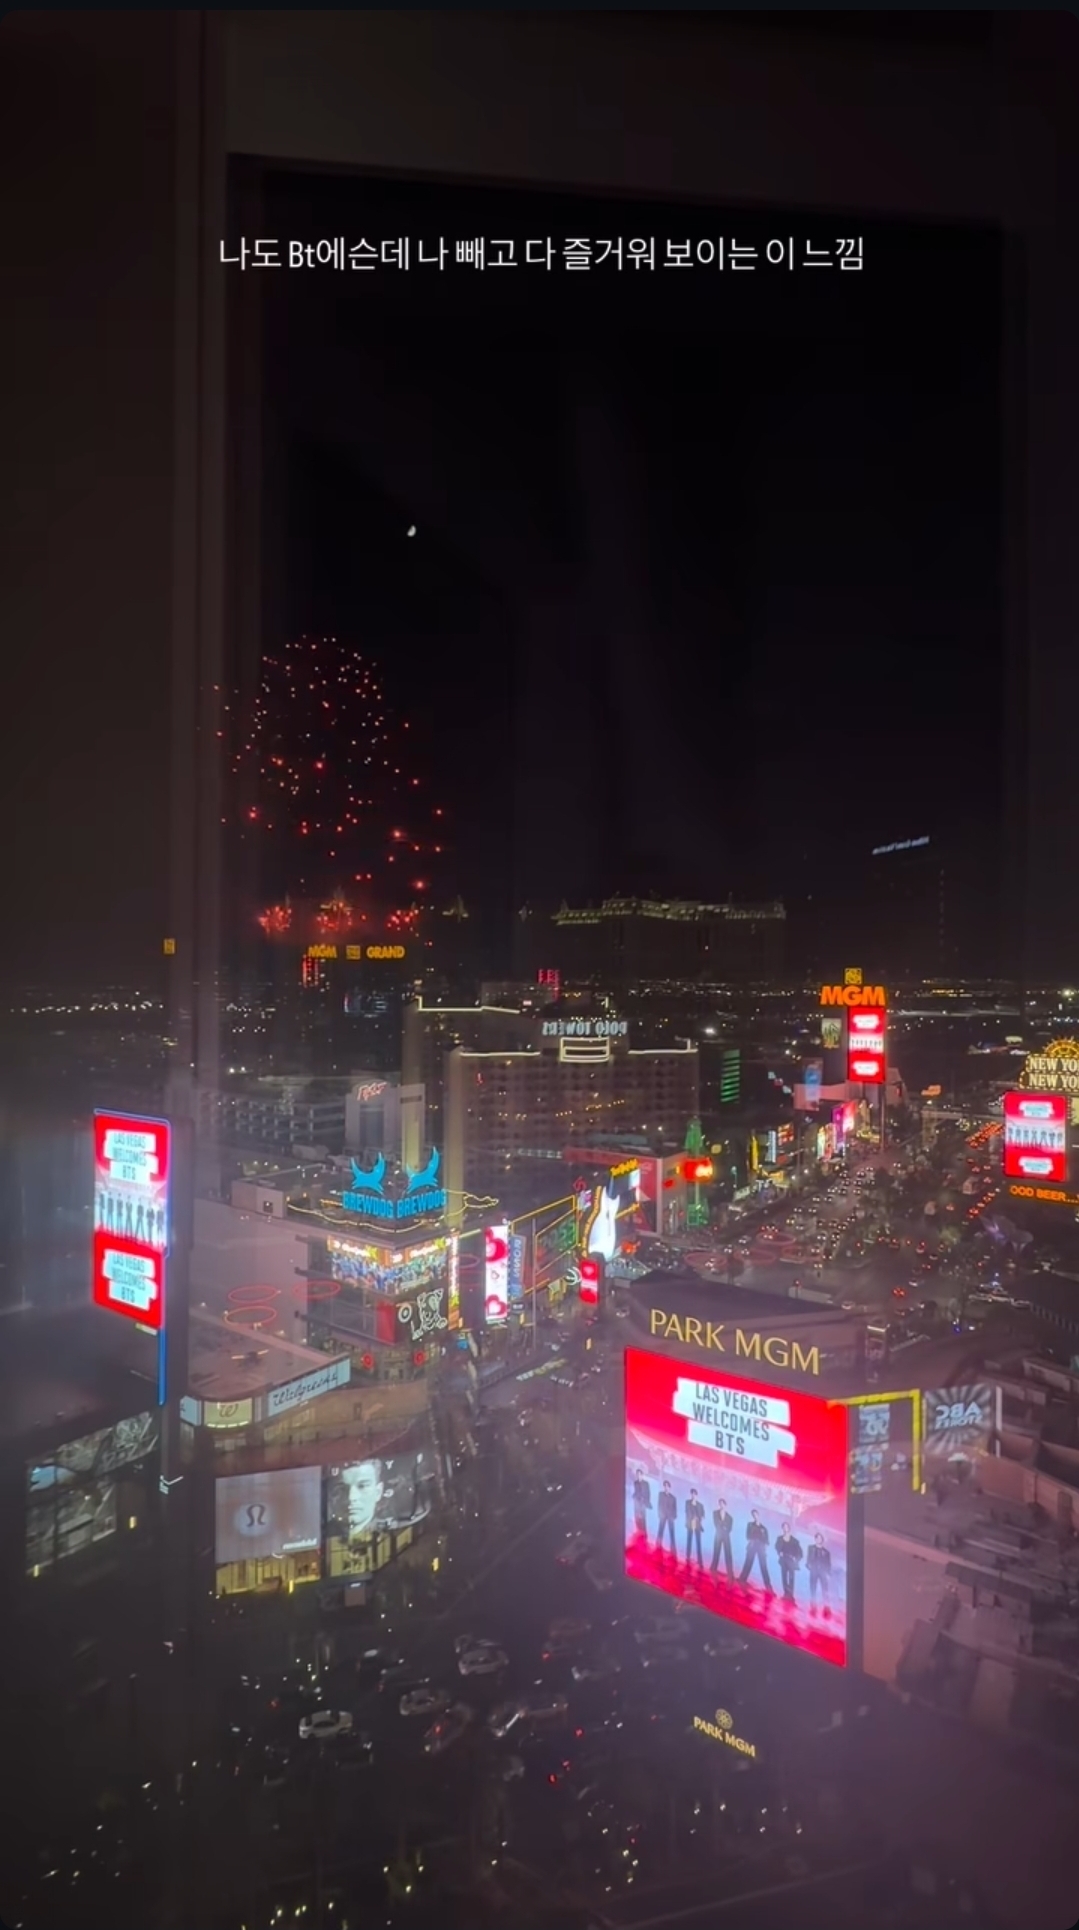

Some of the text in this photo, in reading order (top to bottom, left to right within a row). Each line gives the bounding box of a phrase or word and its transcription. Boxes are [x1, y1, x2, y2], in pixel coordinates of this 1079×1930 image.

[366, 946, 405, 958] GRAND
[820, 985, 886, 1006] MGM
[1029, 1057, 1058, 1071] NEW
[1029, 1074, 1058, 1087] NEW
[113, 1132, 146, 1149] LAS VEGAS
[112, 1147, 147, 1167] WELCOMES
[122, 1165, 136, 1180] BTS
[343, 1190, 395, 1219] BREWDOG
[111, 1267, 146, 1291] WELCOMES
[121, 1286, 135, 1303] BTS
[650, 1308, 820, 1376] PARK MGM
[695, 1382, 768, 1418] LAS VEGAS
[692, 1402, 770, 1442] WELCOMES
[714, 1430, 745, 1455] BTS
[694, 1715, 755, 1757] PARK MGM
